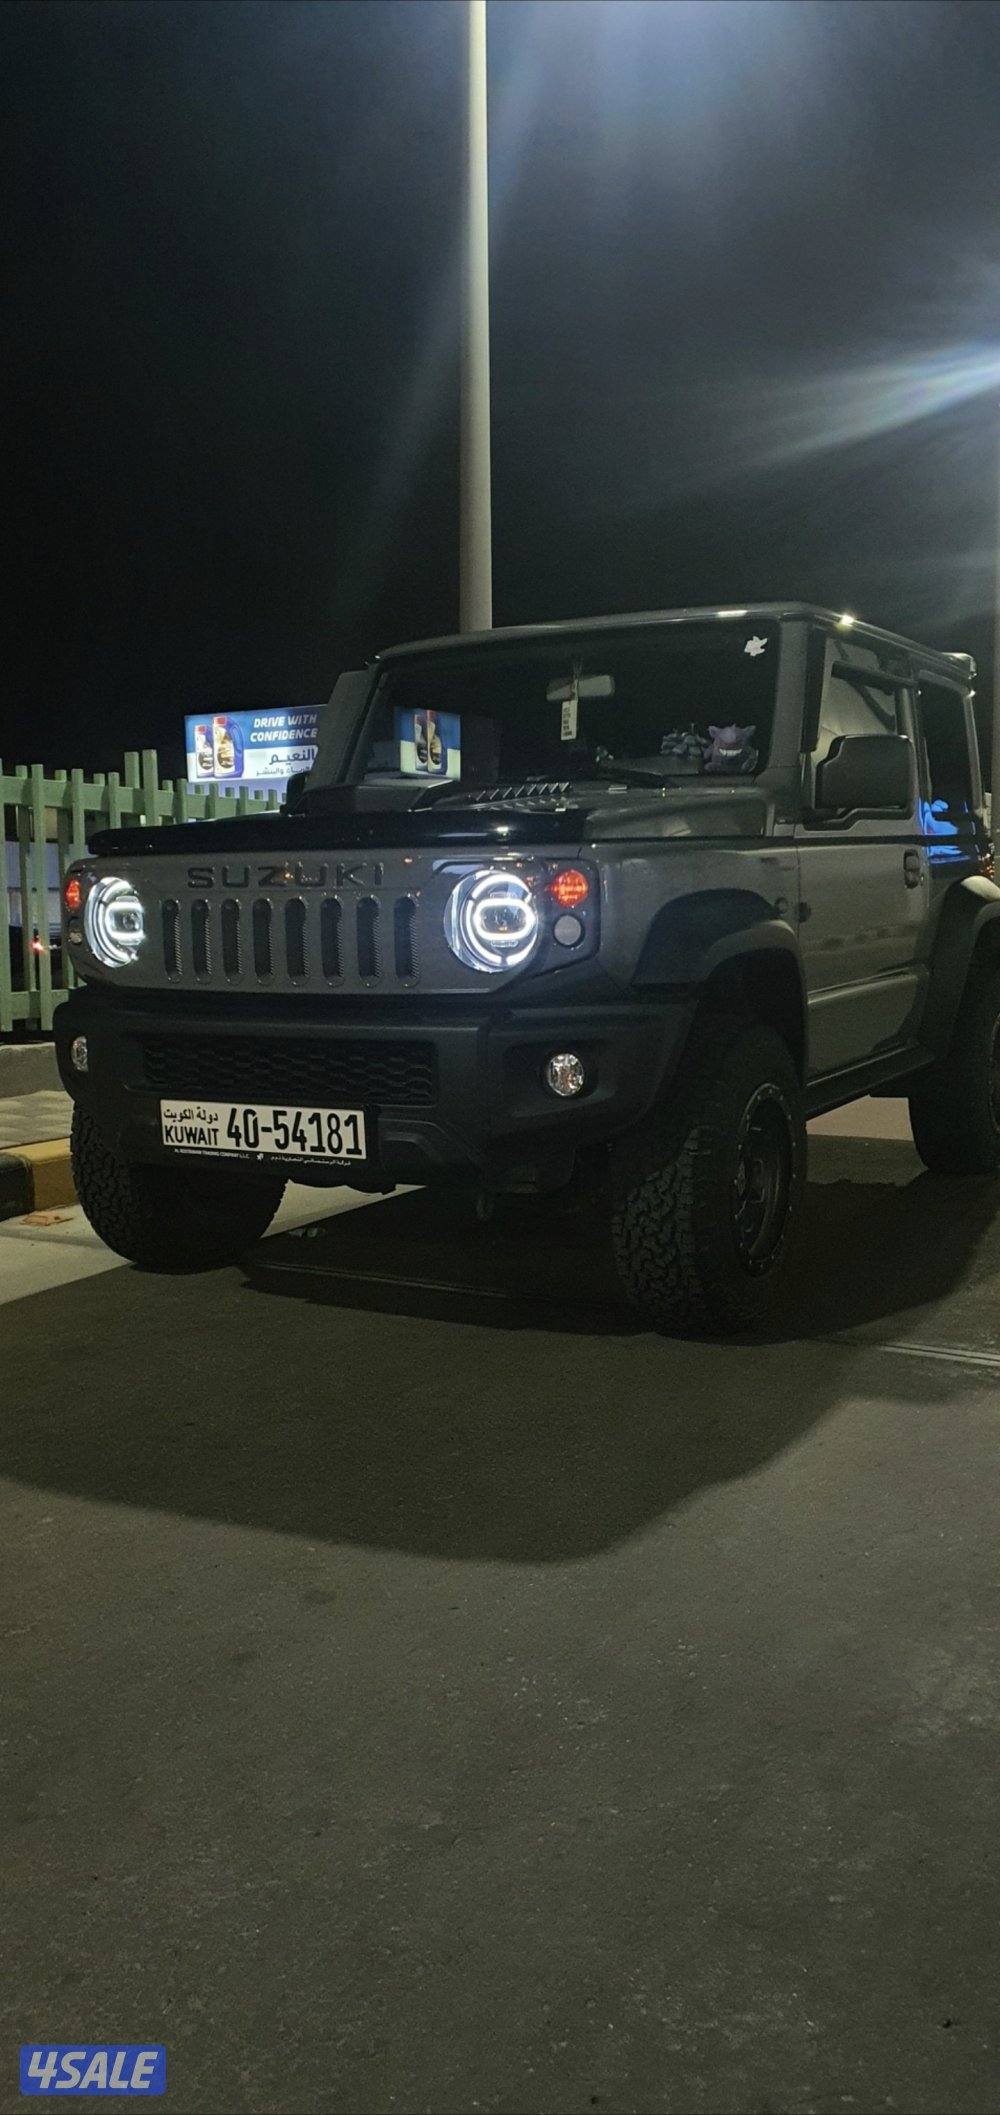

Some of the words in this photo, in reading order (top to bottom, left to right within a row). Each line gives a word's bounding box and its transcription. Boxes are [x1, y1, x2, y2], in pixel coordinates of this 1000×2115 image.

[254, 716, 285, 728] DRIVE
[287, 714, 318, 725] WITH
[250, 728, 318, 742] CONFIDENCE
[188, 863, 384, 888] SUZUKI
[163, 1108, 194, 1123] الكويت
[196, 1106, 219, 1124] دولة
[164, 1125, 219, 1146] KUWAIT
[227, 1107, 363, 1156] 40-54181
